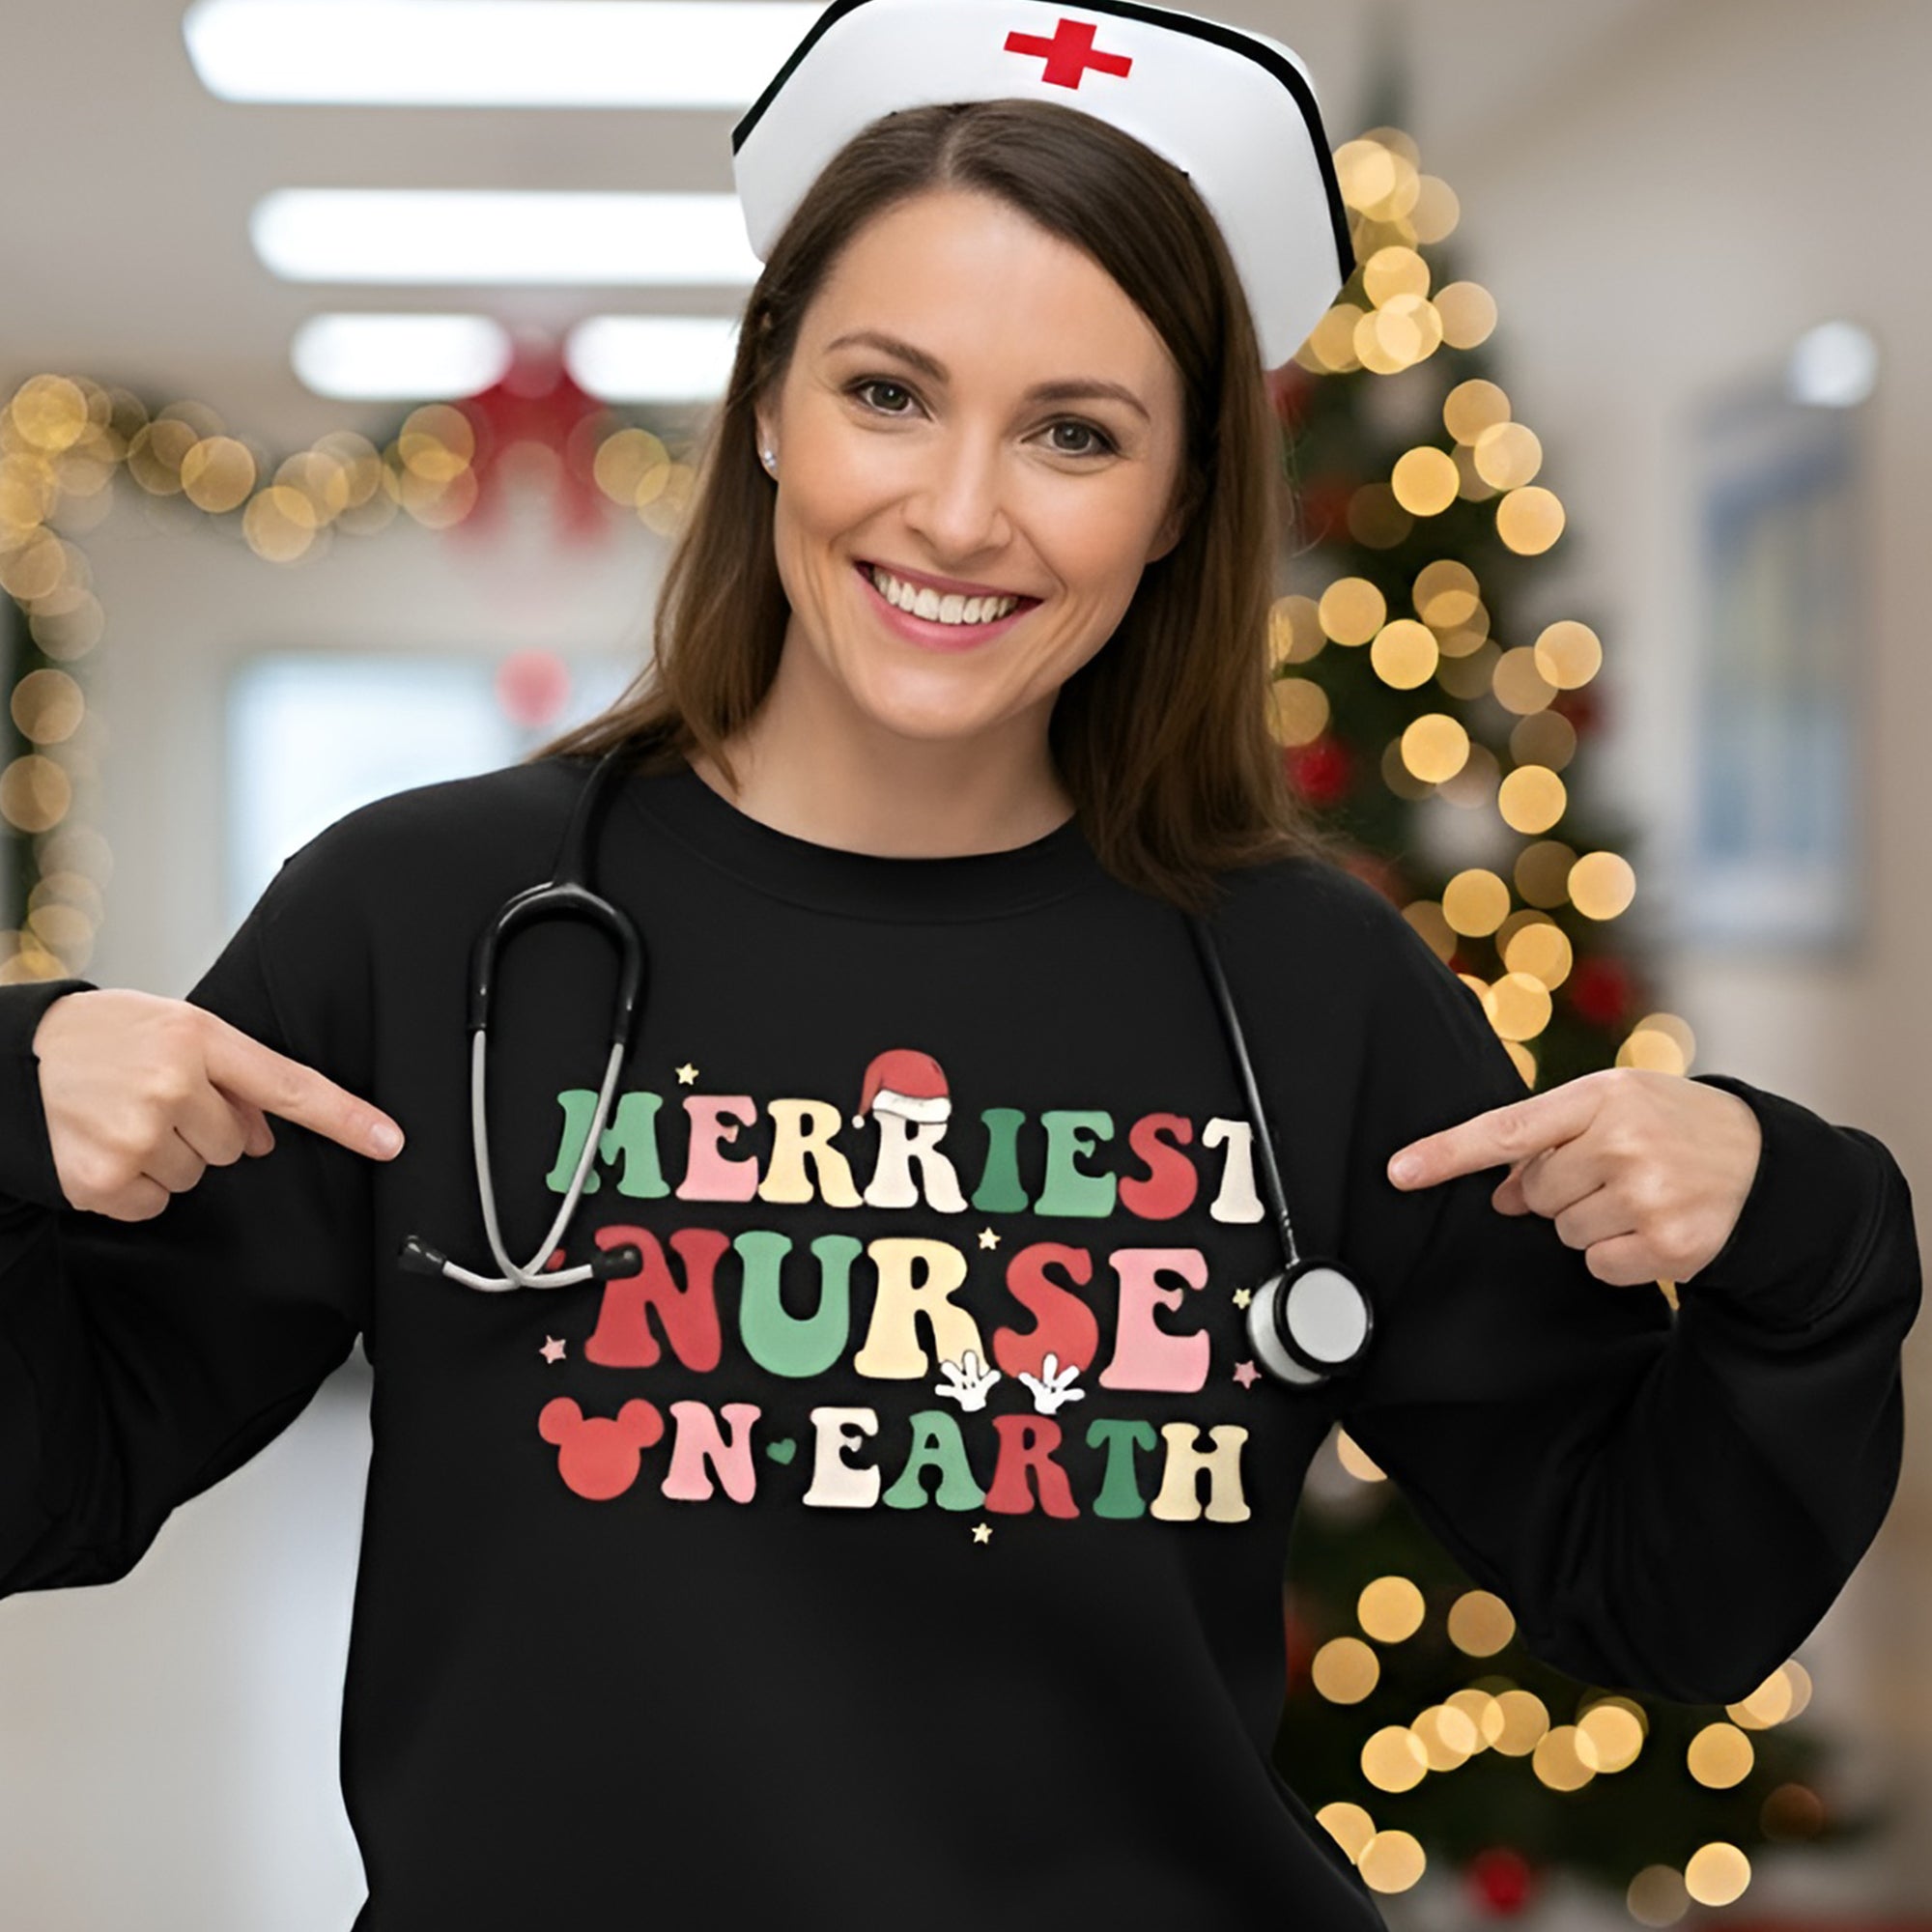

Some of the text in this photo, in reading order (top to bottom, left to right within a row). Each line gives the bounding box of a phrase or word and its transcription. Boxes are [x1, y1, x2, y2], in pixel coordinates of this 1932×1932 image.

[546, 1089, 1265, 1224] MERRIEST
[584, 1224, 1210, 1393] NURSE
[802, 1406, 1252, 1522] EARTH
